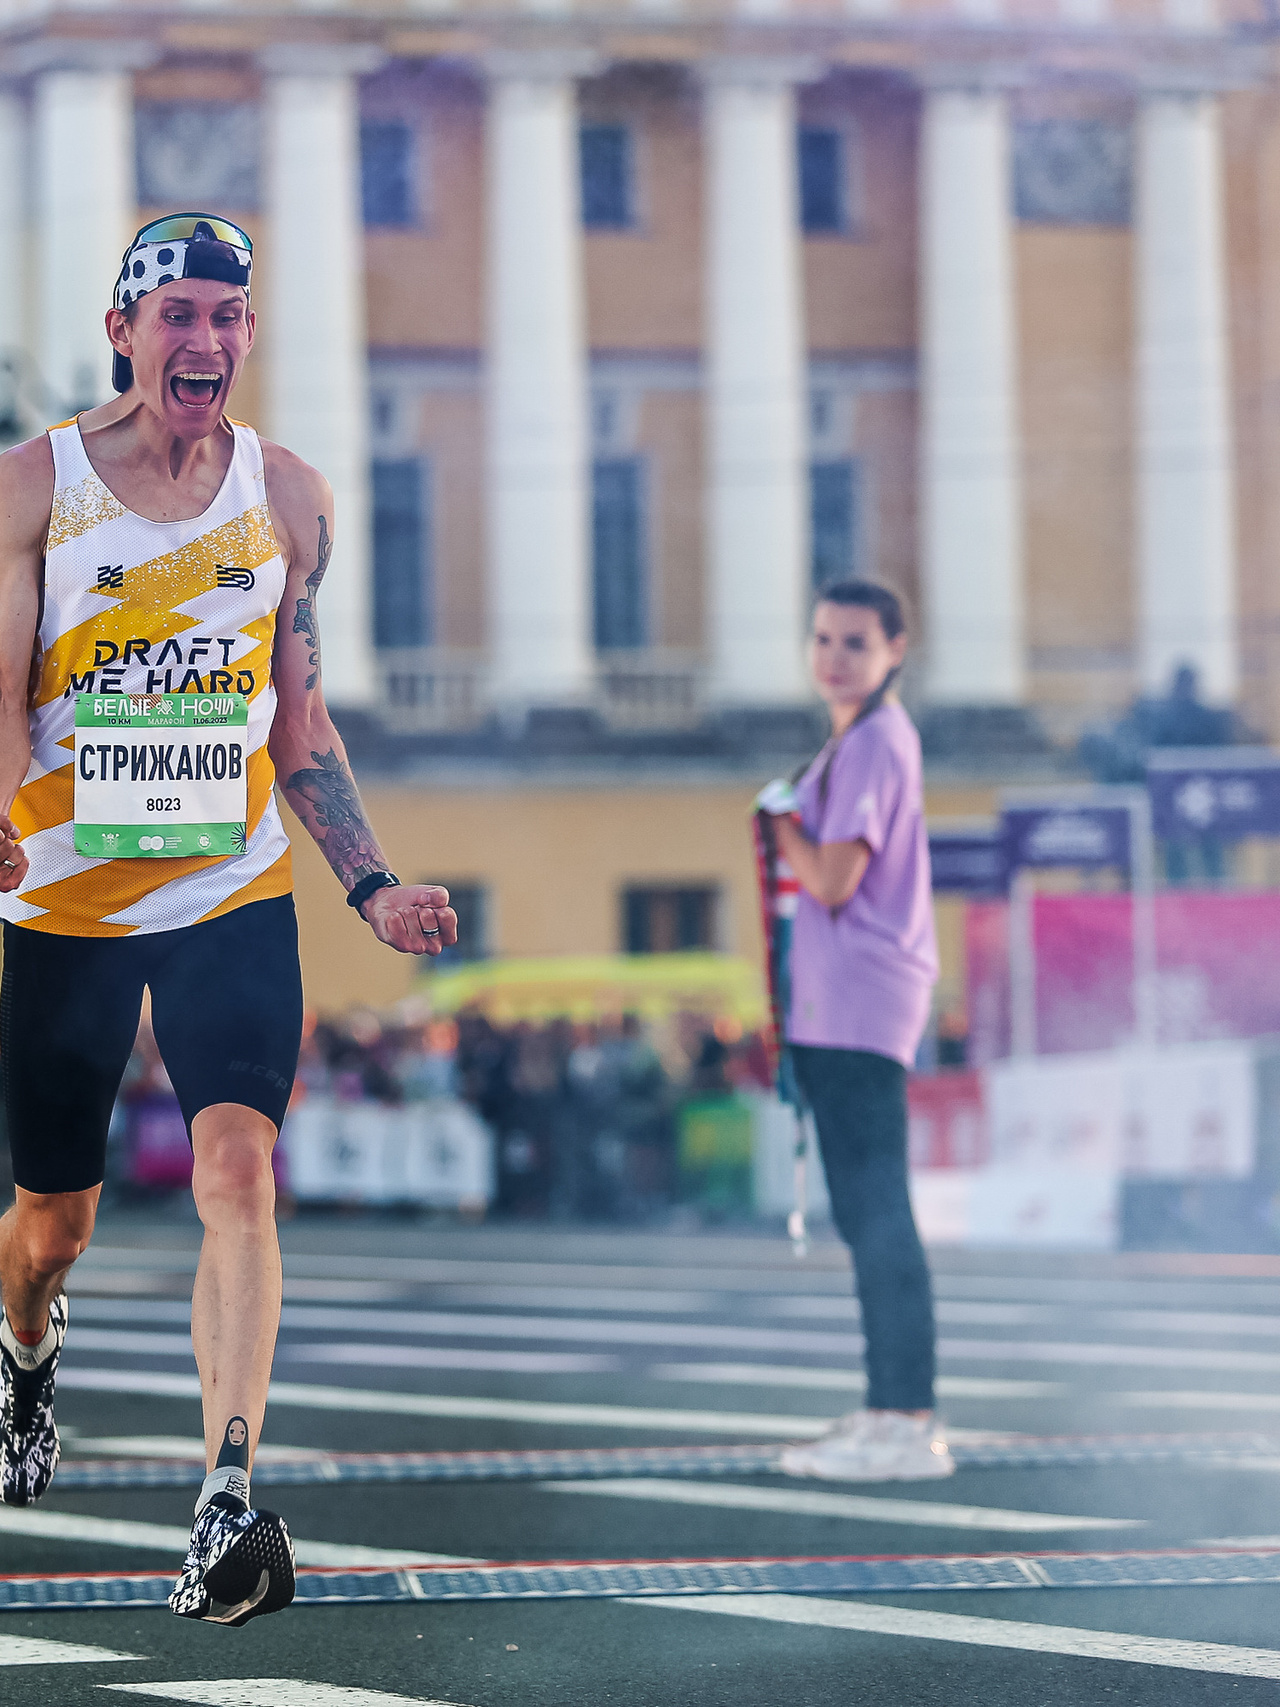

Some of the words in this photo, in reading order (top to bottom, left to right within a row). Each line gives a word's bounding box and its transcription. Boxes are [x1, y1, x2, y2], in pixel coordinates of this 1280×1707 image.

[93, 638, 235, 666] DRAFT
[64, 667, 125, 698] ME
[146, 668, 255, 697] HARD
[93, 699, 151, 717] БЕЛЫЕ
[181, 699, 235, 716] НОЧИ
[192, 717, 228, 725] 11.06.2023
[79, 743, 242, 781] СТРИЖАКОВ
[146, 798, 181, 811] 8023
